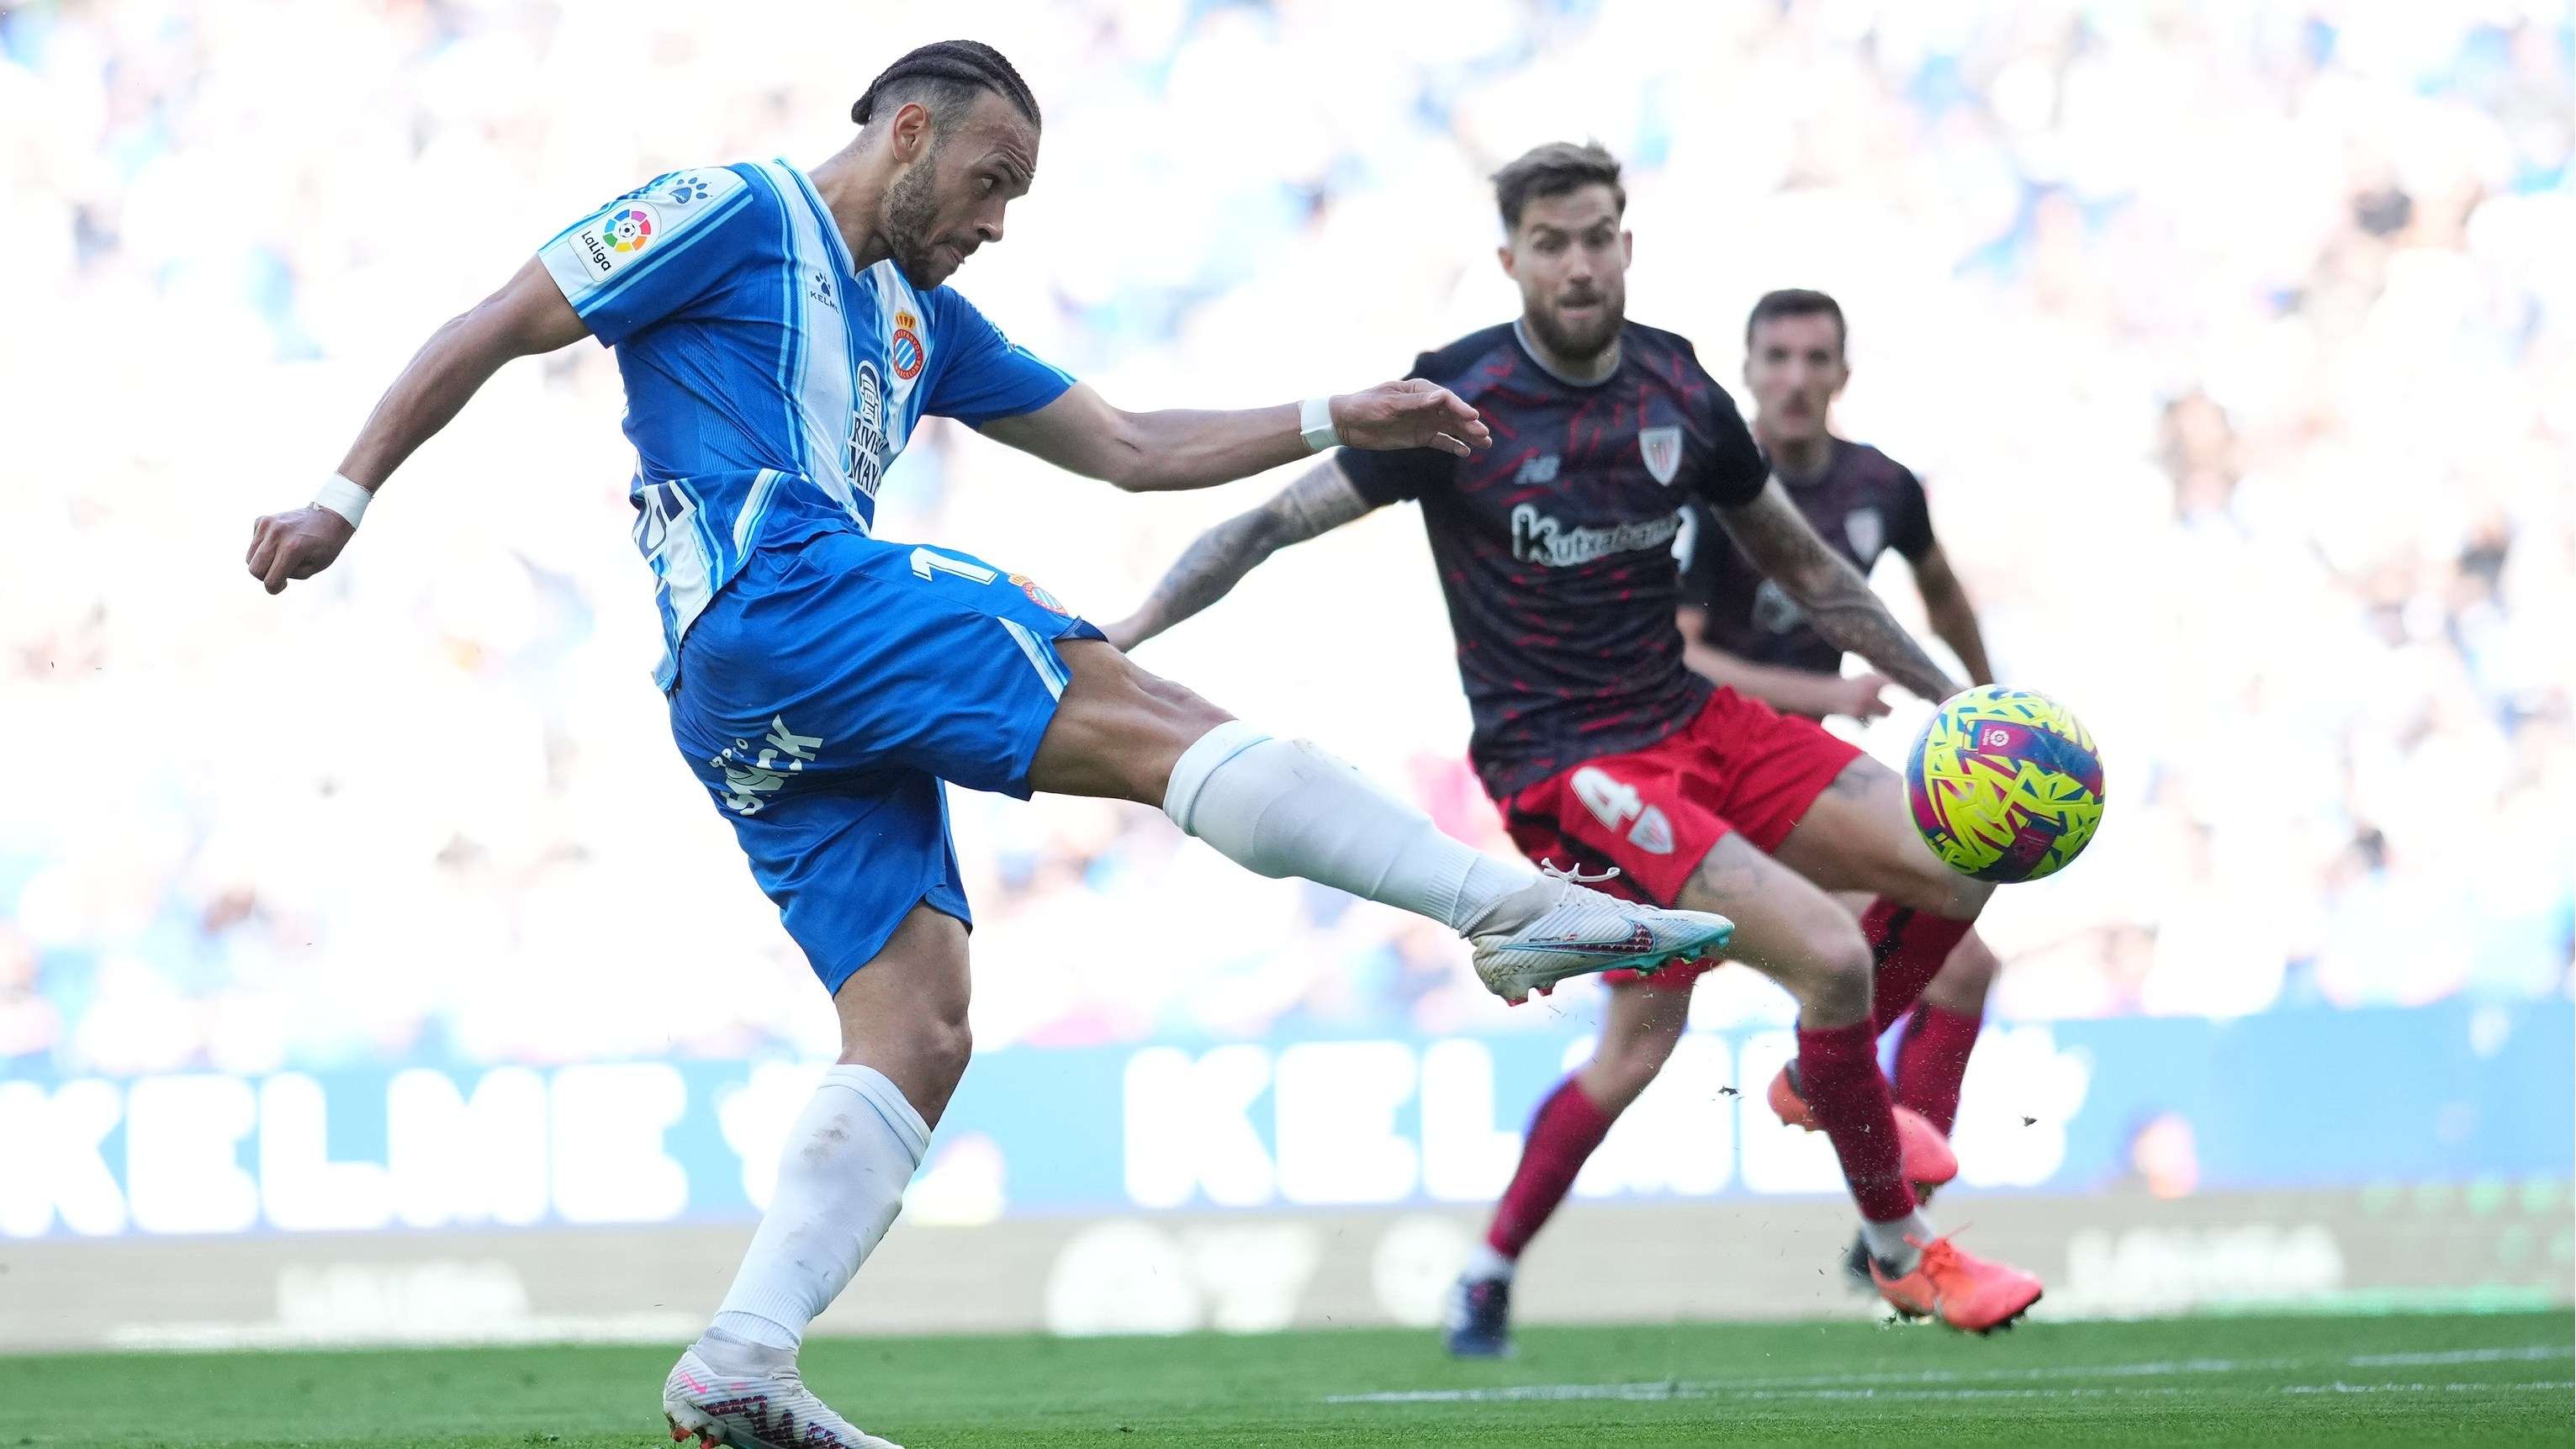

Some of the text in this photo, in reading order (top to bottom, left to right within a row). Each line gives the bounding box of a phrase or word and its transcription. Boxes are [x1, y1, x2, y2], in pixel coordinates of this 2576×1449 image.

[581, 231, 612, 272] LaLiga
[1569, 766, 1644, 833] 4
[0, 1062, 688, 1235] KELME
